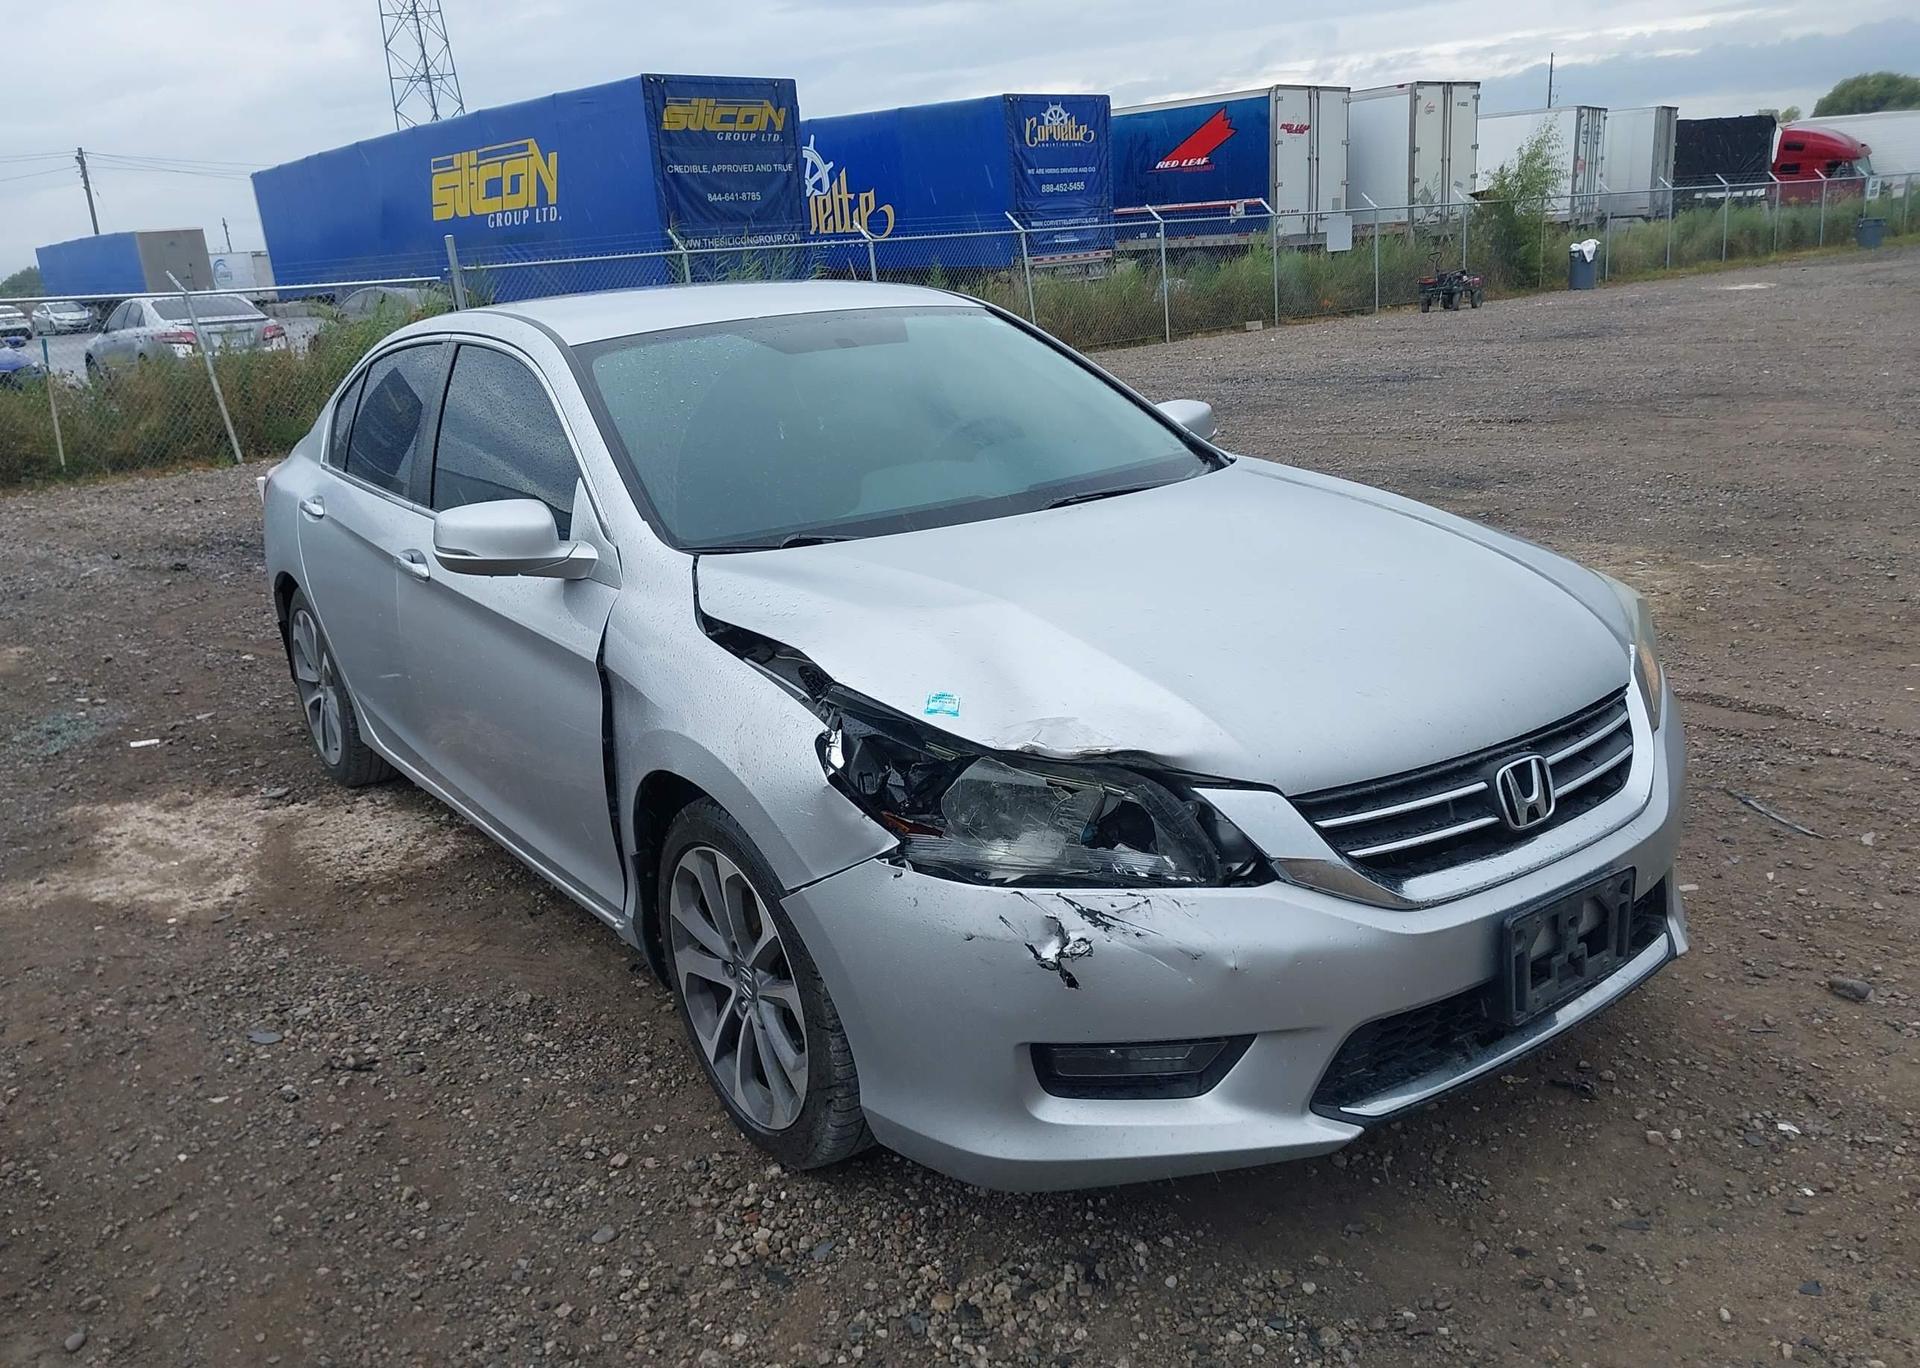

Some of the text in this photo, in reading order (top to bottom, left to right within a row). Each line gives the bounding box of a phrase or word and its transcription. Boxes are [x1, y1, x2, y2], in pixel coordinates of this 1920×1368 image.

[716, 132, 784, 142] GROUP LTD.
[1025, 115, 1095, 147] Corvette
[667, 163, 793, 174] CREDIBLE, APPROVED AND TRUE
[1155, 159, 1180, 170] RED
[1181, 156, 1211, 167] LEAF
[1041, 181, 1085, 193] 888-452-5455
[707, 191, 761, 202] 844-641-8785
[487, 206, 562, 228] GROUP LTD.
